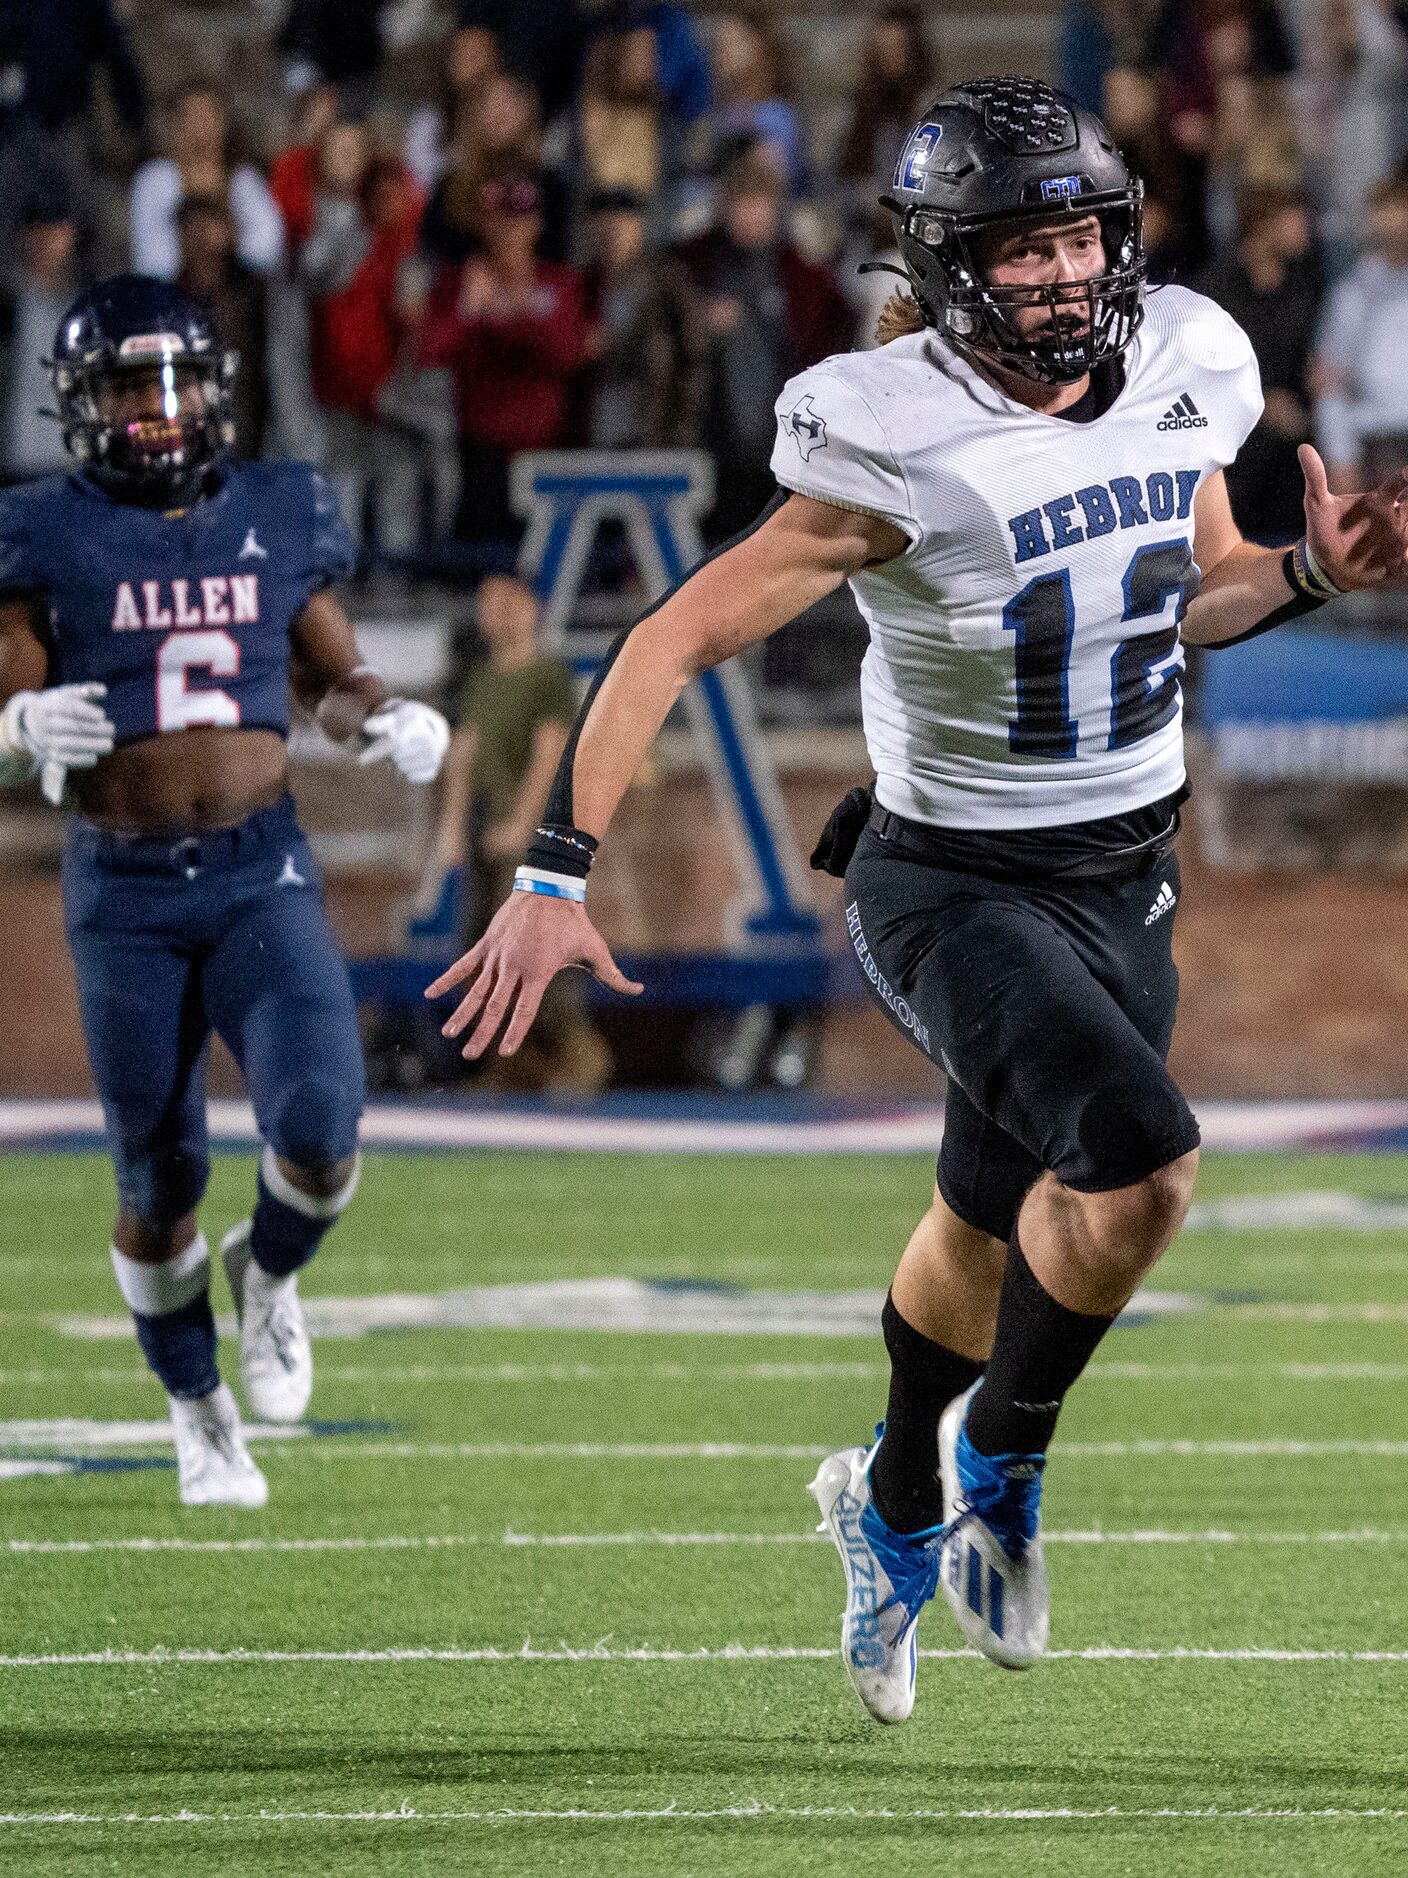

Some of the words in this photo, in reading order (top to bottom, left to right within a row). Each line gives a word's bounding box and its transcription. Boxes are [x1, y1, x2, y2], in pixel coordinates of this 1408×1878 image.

[1156, 415, 1209, 432] adidas
[111, 574, 260, 632] ALLEN
[157, 628, 241, 732] 6
[1002, 535, 1202, 759] 12
[1144, 895, 1177, 926] adidas
[845, 900, 932, 1055] HEBRON
